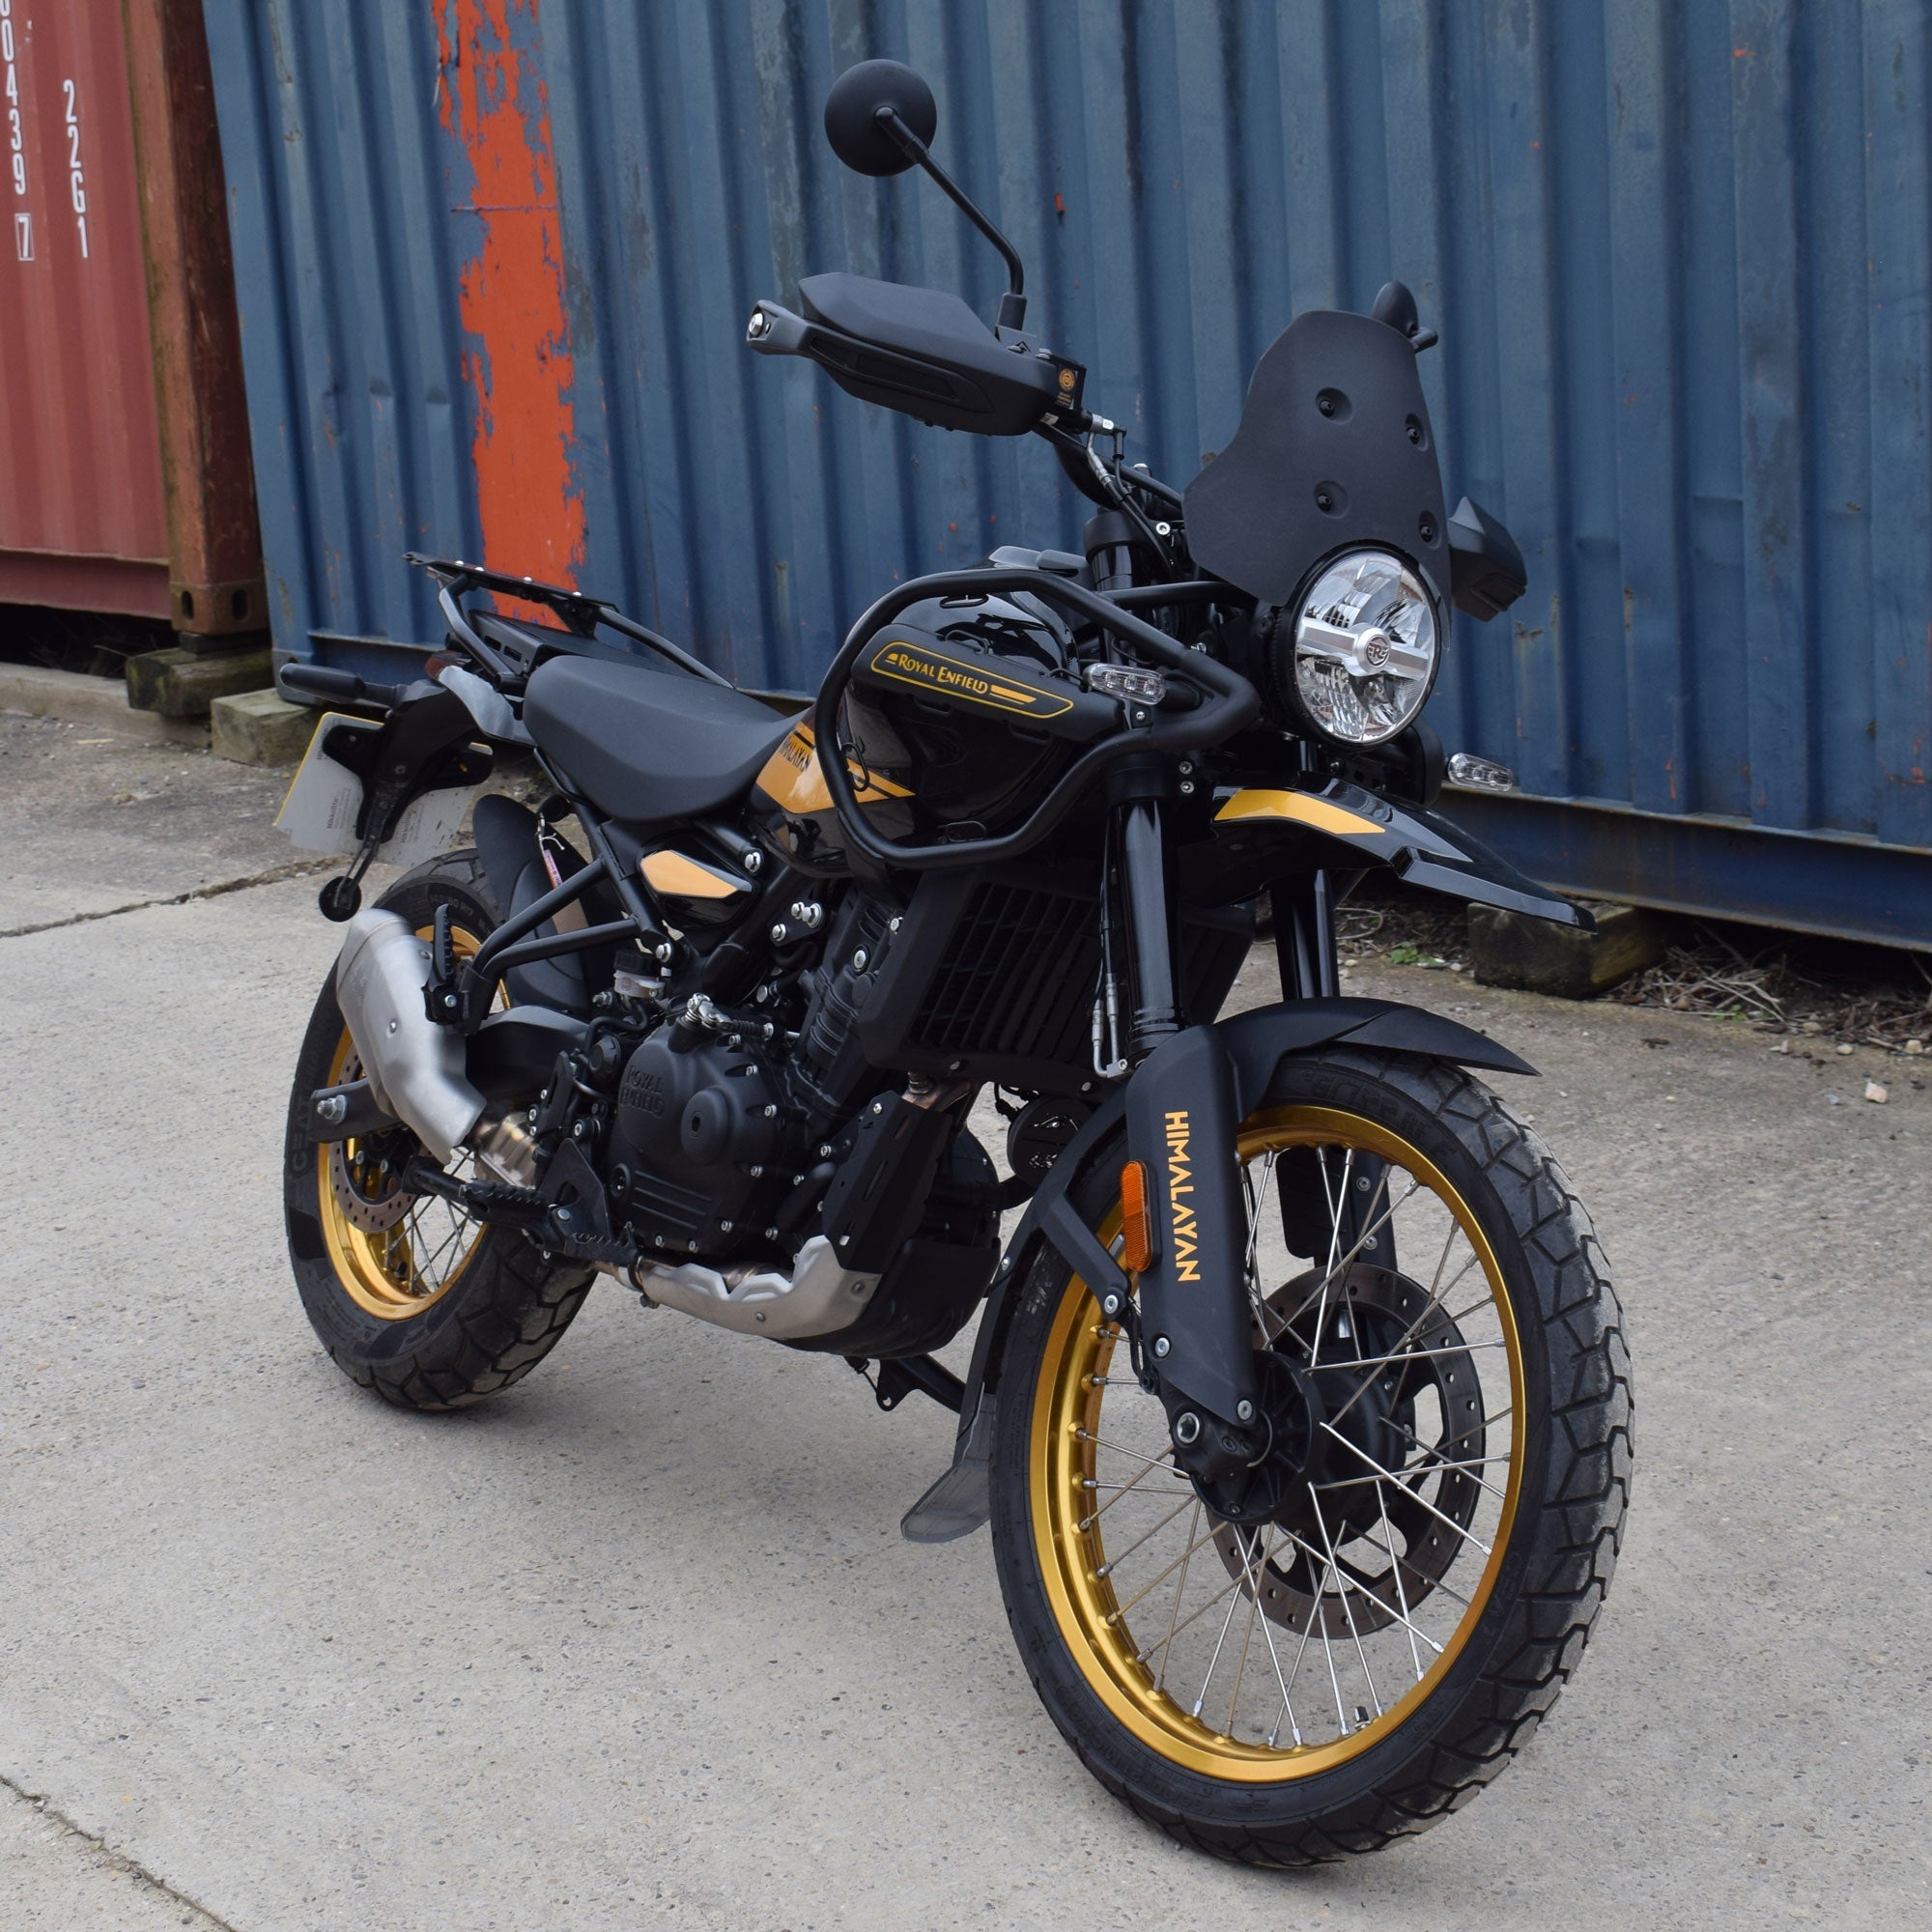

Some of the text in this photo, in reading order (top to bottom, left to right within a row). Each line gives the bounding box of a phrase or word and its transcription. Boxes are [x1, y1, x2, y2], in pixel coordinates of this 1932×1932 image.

[63, 79, 88, 258] 22G1
[16, 215, 31, 259] 7
[898, 654, 988, 695] ROYAL ENFIELD
[1164, 1111, 1201, 1282] HIMALAYAN
